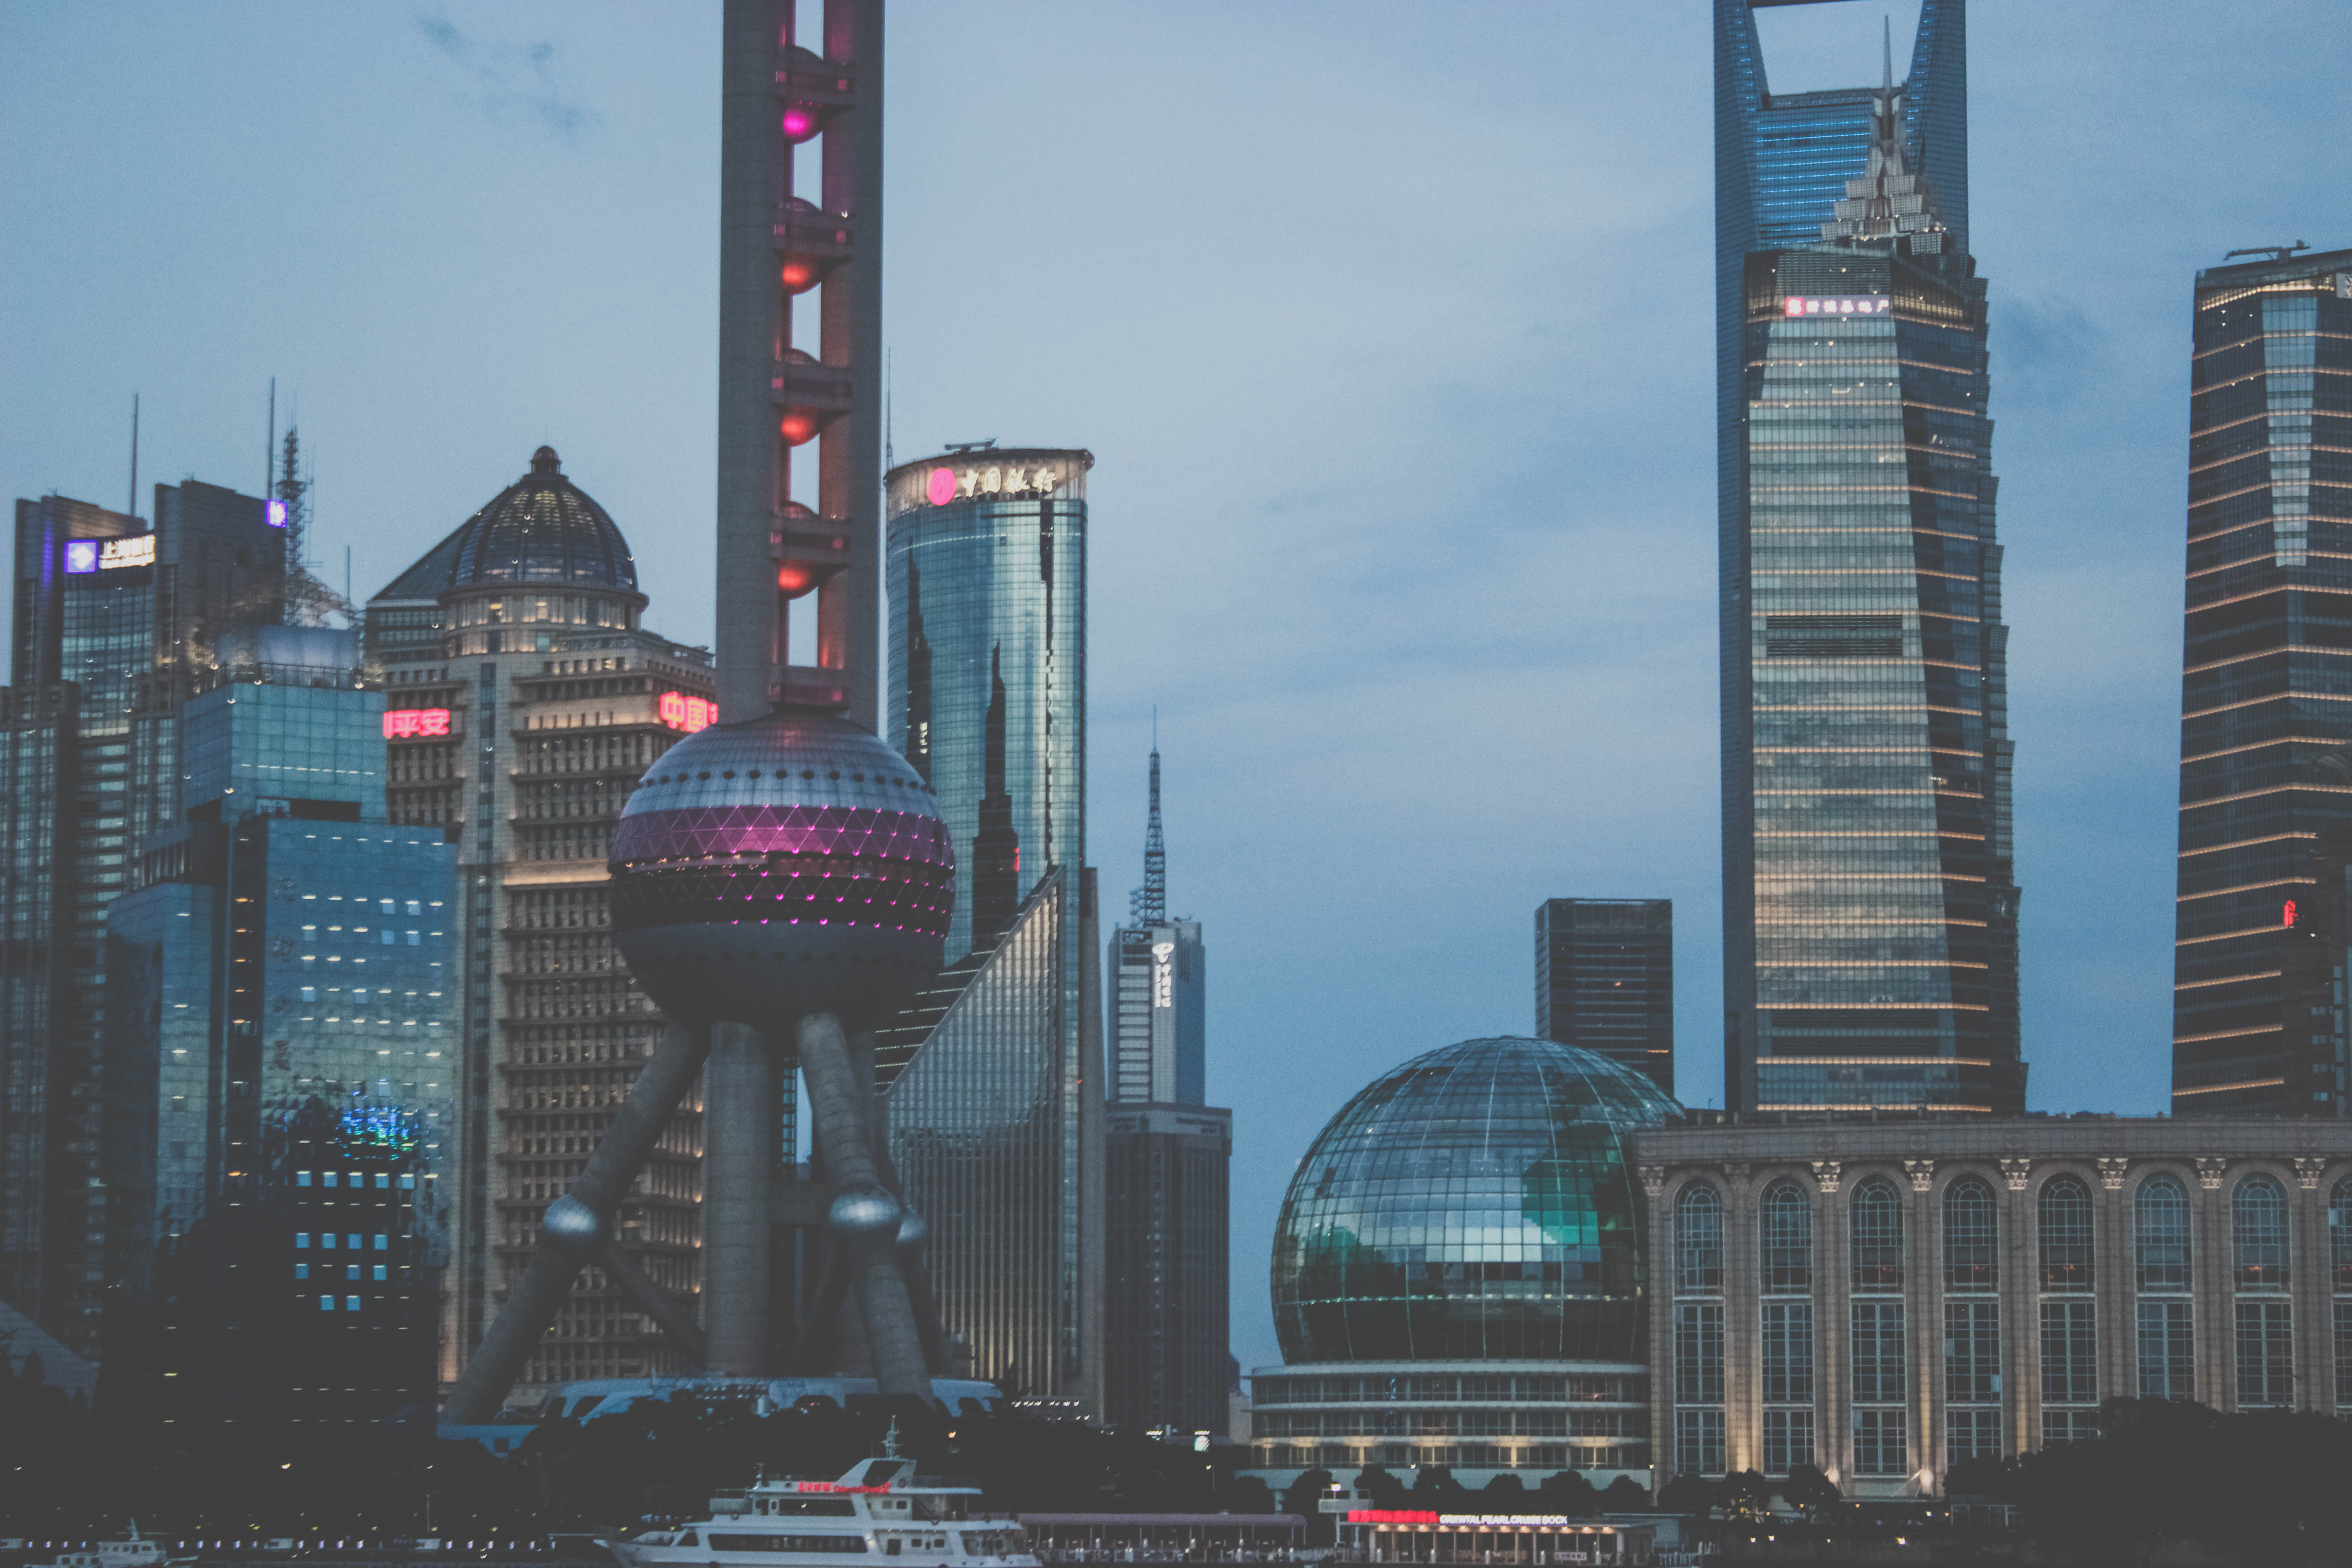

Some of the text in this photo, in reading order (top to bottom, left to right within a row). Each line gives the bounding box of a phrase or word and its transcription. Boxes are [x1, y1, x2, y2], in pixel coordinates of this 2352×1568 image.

[960, 467, 1057, 497] 中国银行
[382, 708, 450, 739] 平安
[1440, 1514, 1481, 1525] ORIENTAL
[1481, 1515, 1510, 1525] PEARL
[1510, 1515, 1542, 1525] CRUISE
[1542, 1515, 1568, 1525] DOCK
